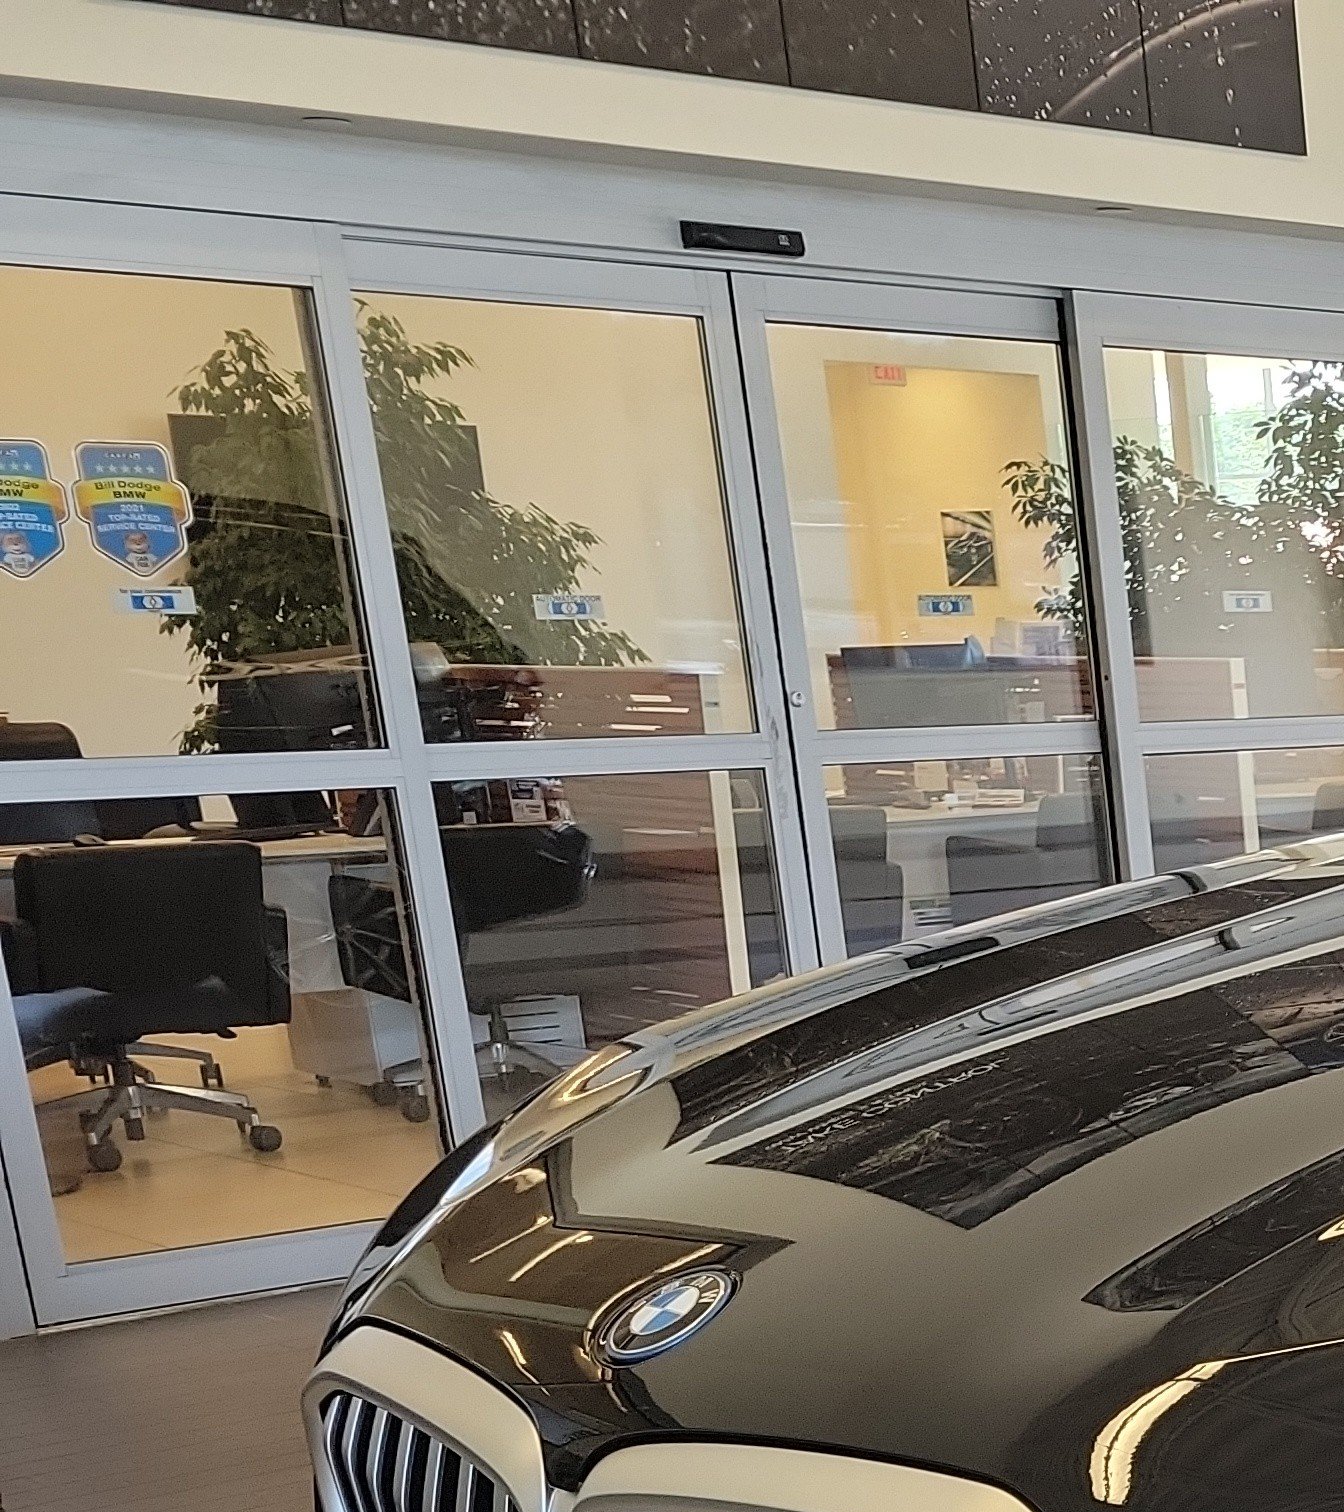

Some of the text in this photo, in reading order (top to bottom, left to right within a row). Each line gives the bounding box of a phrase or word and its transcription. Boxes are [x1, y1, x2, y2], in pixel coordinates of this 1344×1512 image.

[94, 480, 161, 492] Bill Dodge
[113, 491, 146, 499] BMW
